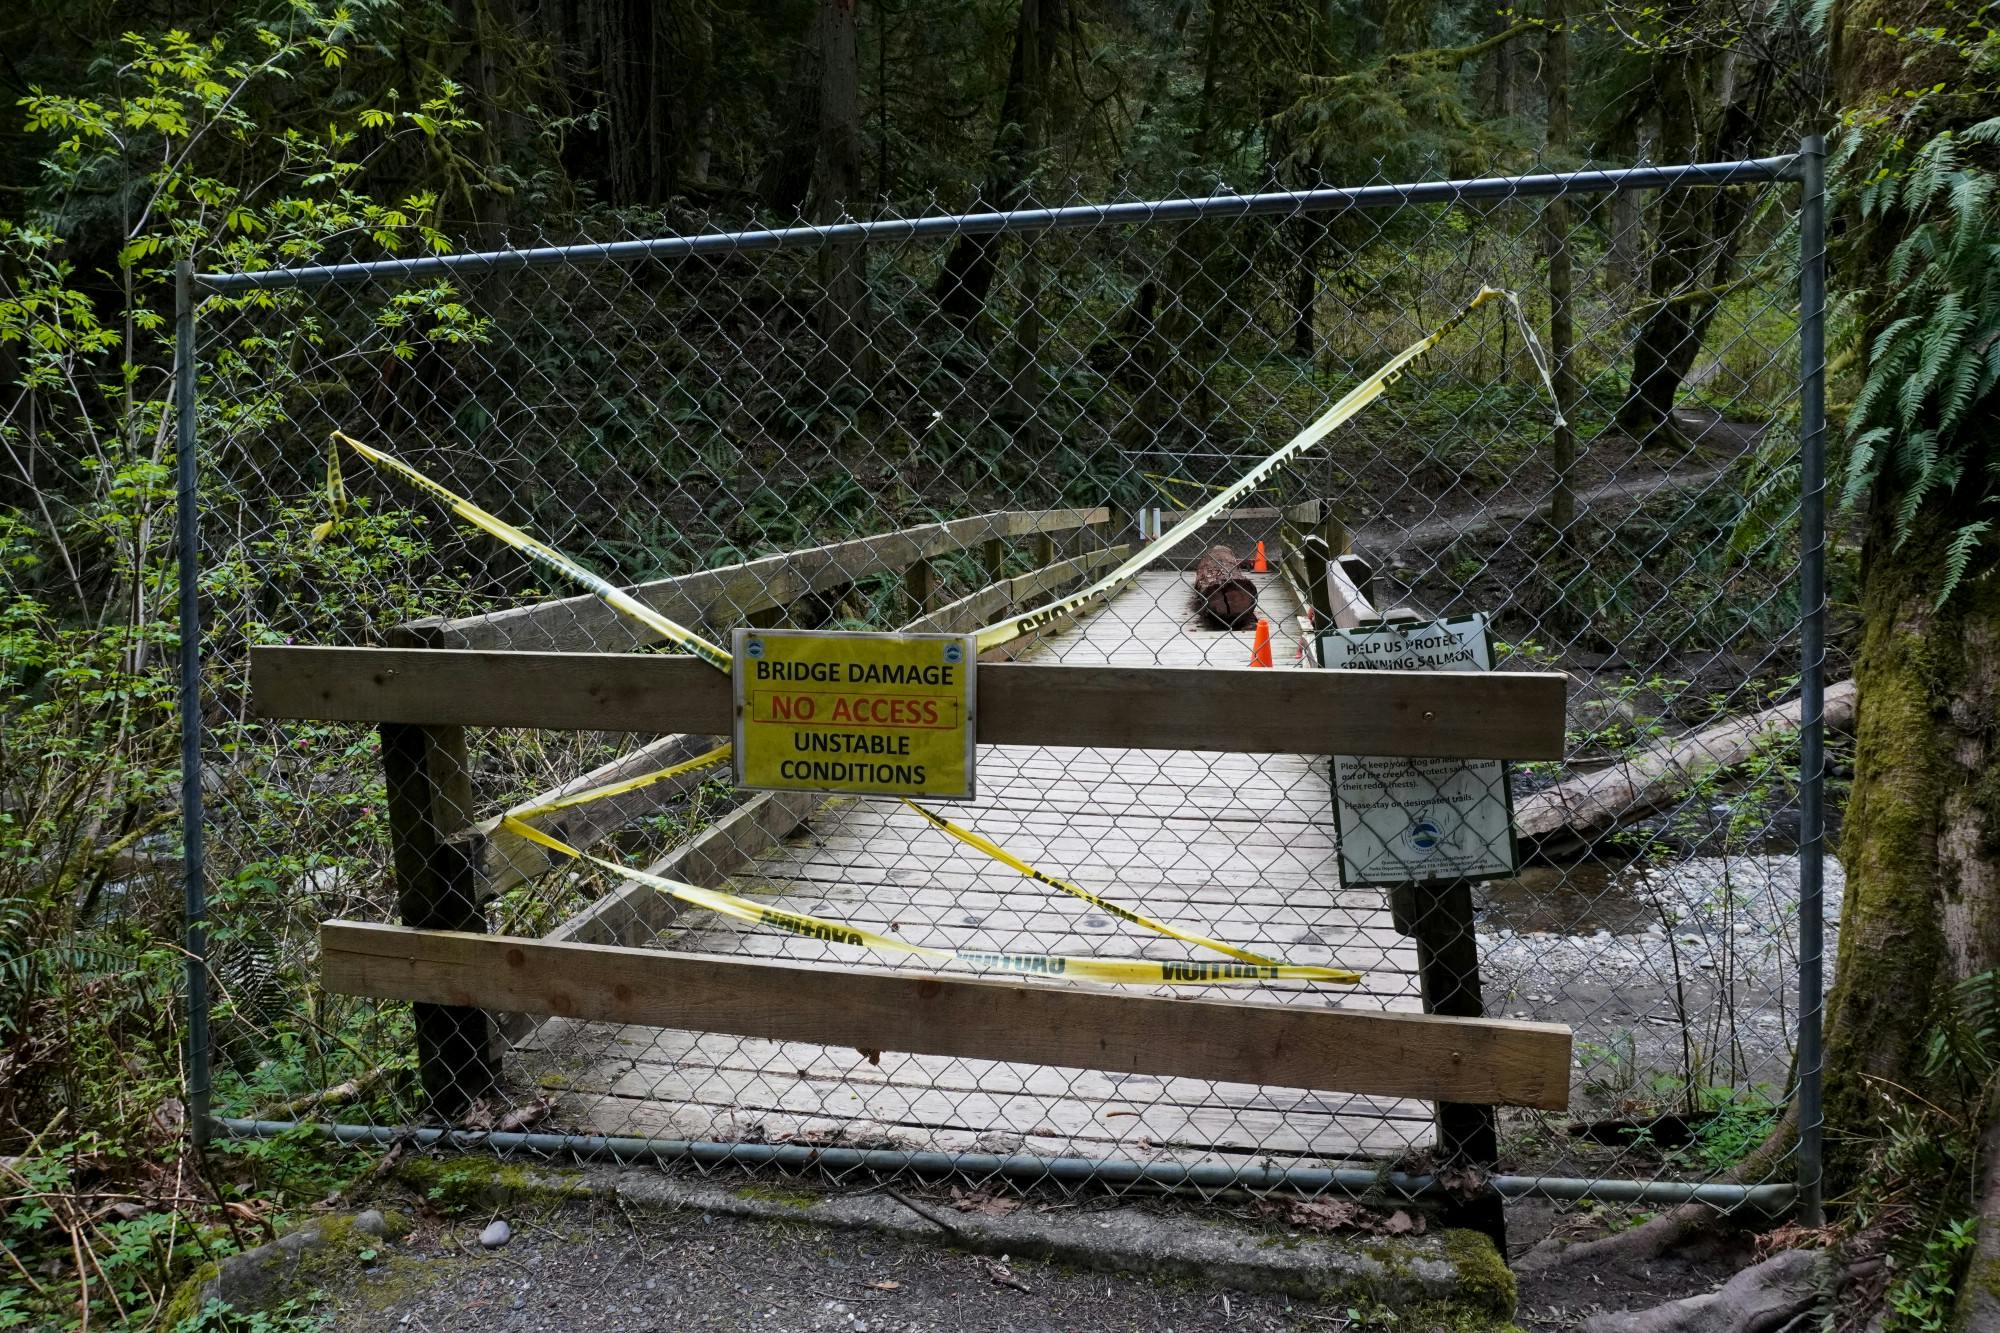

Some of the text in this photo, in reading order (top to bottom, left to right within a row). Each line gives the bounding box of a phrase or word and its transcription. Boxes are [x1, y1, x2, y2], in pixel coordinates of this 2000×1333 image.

[1346, 632, 1465, 656] HELP US PROTECT
[1340, 649, 1475, 671] SPAWNING SALMON
[757, 661, 954, 685] BRIDGE DAMAGE
[771, 695, 939, 725] NO ACCESS
[794, 733, 910, 756] UNSTABLE
[780, 760, 926, 785] CONDITIONS
[1340, 762, 1367, 770] Pleae
[1368, 760, 1389, 769] keep
[1357, 770, 1367, 779] of
[1406, 769, 1415, 777] to
[1479, 760, 1496, 769] and
[1363, 781, 1388, 790] redd
[1344, 802, 1372, 810] Please
[1372, 799, 1389, 809] stay
